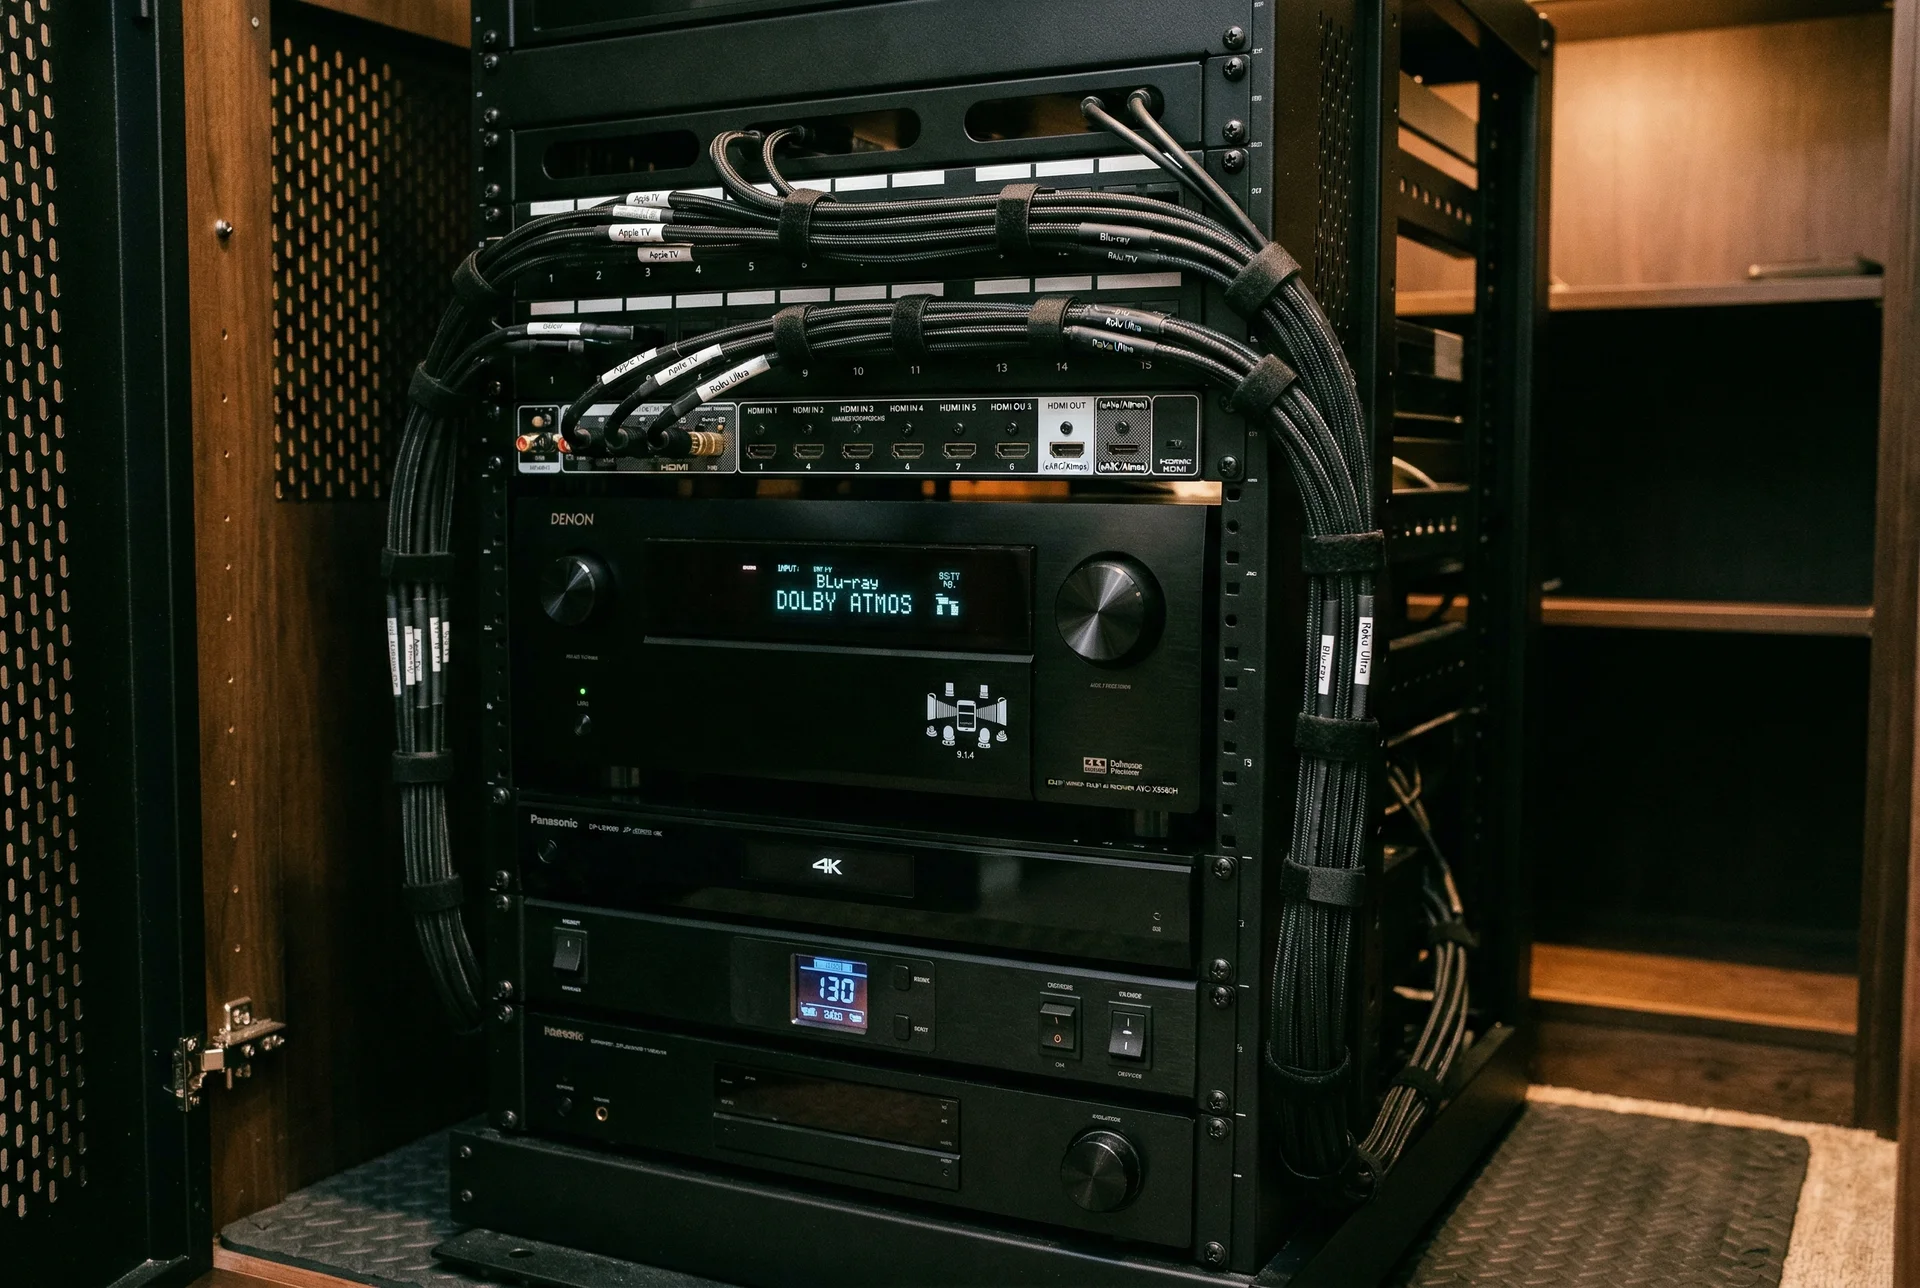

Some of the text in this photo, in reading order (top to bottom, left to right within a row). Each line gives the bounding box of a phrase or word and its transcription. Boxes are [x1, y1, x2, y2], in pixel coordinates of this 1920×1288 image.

[618, 228, 651, 238] Apple TV
[695, 264, 702, 273] 4
[749, 262, 755, 271] 5
[596, 270, 602, 280] 2
[645, 267, 651, 277] 3
[549, 274, 554, 282] 1
[853, 366, 865, 376] 10
[910, 365, 921, 375] 11
[996, 362, 1008, 373] 13
[1056, 362, 1069, 372] 14
[802, 368, 809, 378] 9
[551, 513, 594, 526] DENON
[776, 590, 912, 615] DOLBY ATMOS
[1359, 622, 1371, 674] Roku Ultra
[1319, 645, 1331, 682] Blu-ray
[956, 750, 975, 759] 9.1.4
[530, 814, 578, 829] Panasonic
[812, 857, 843, 876] 4K
[819, 976, 855, 1004] 130
